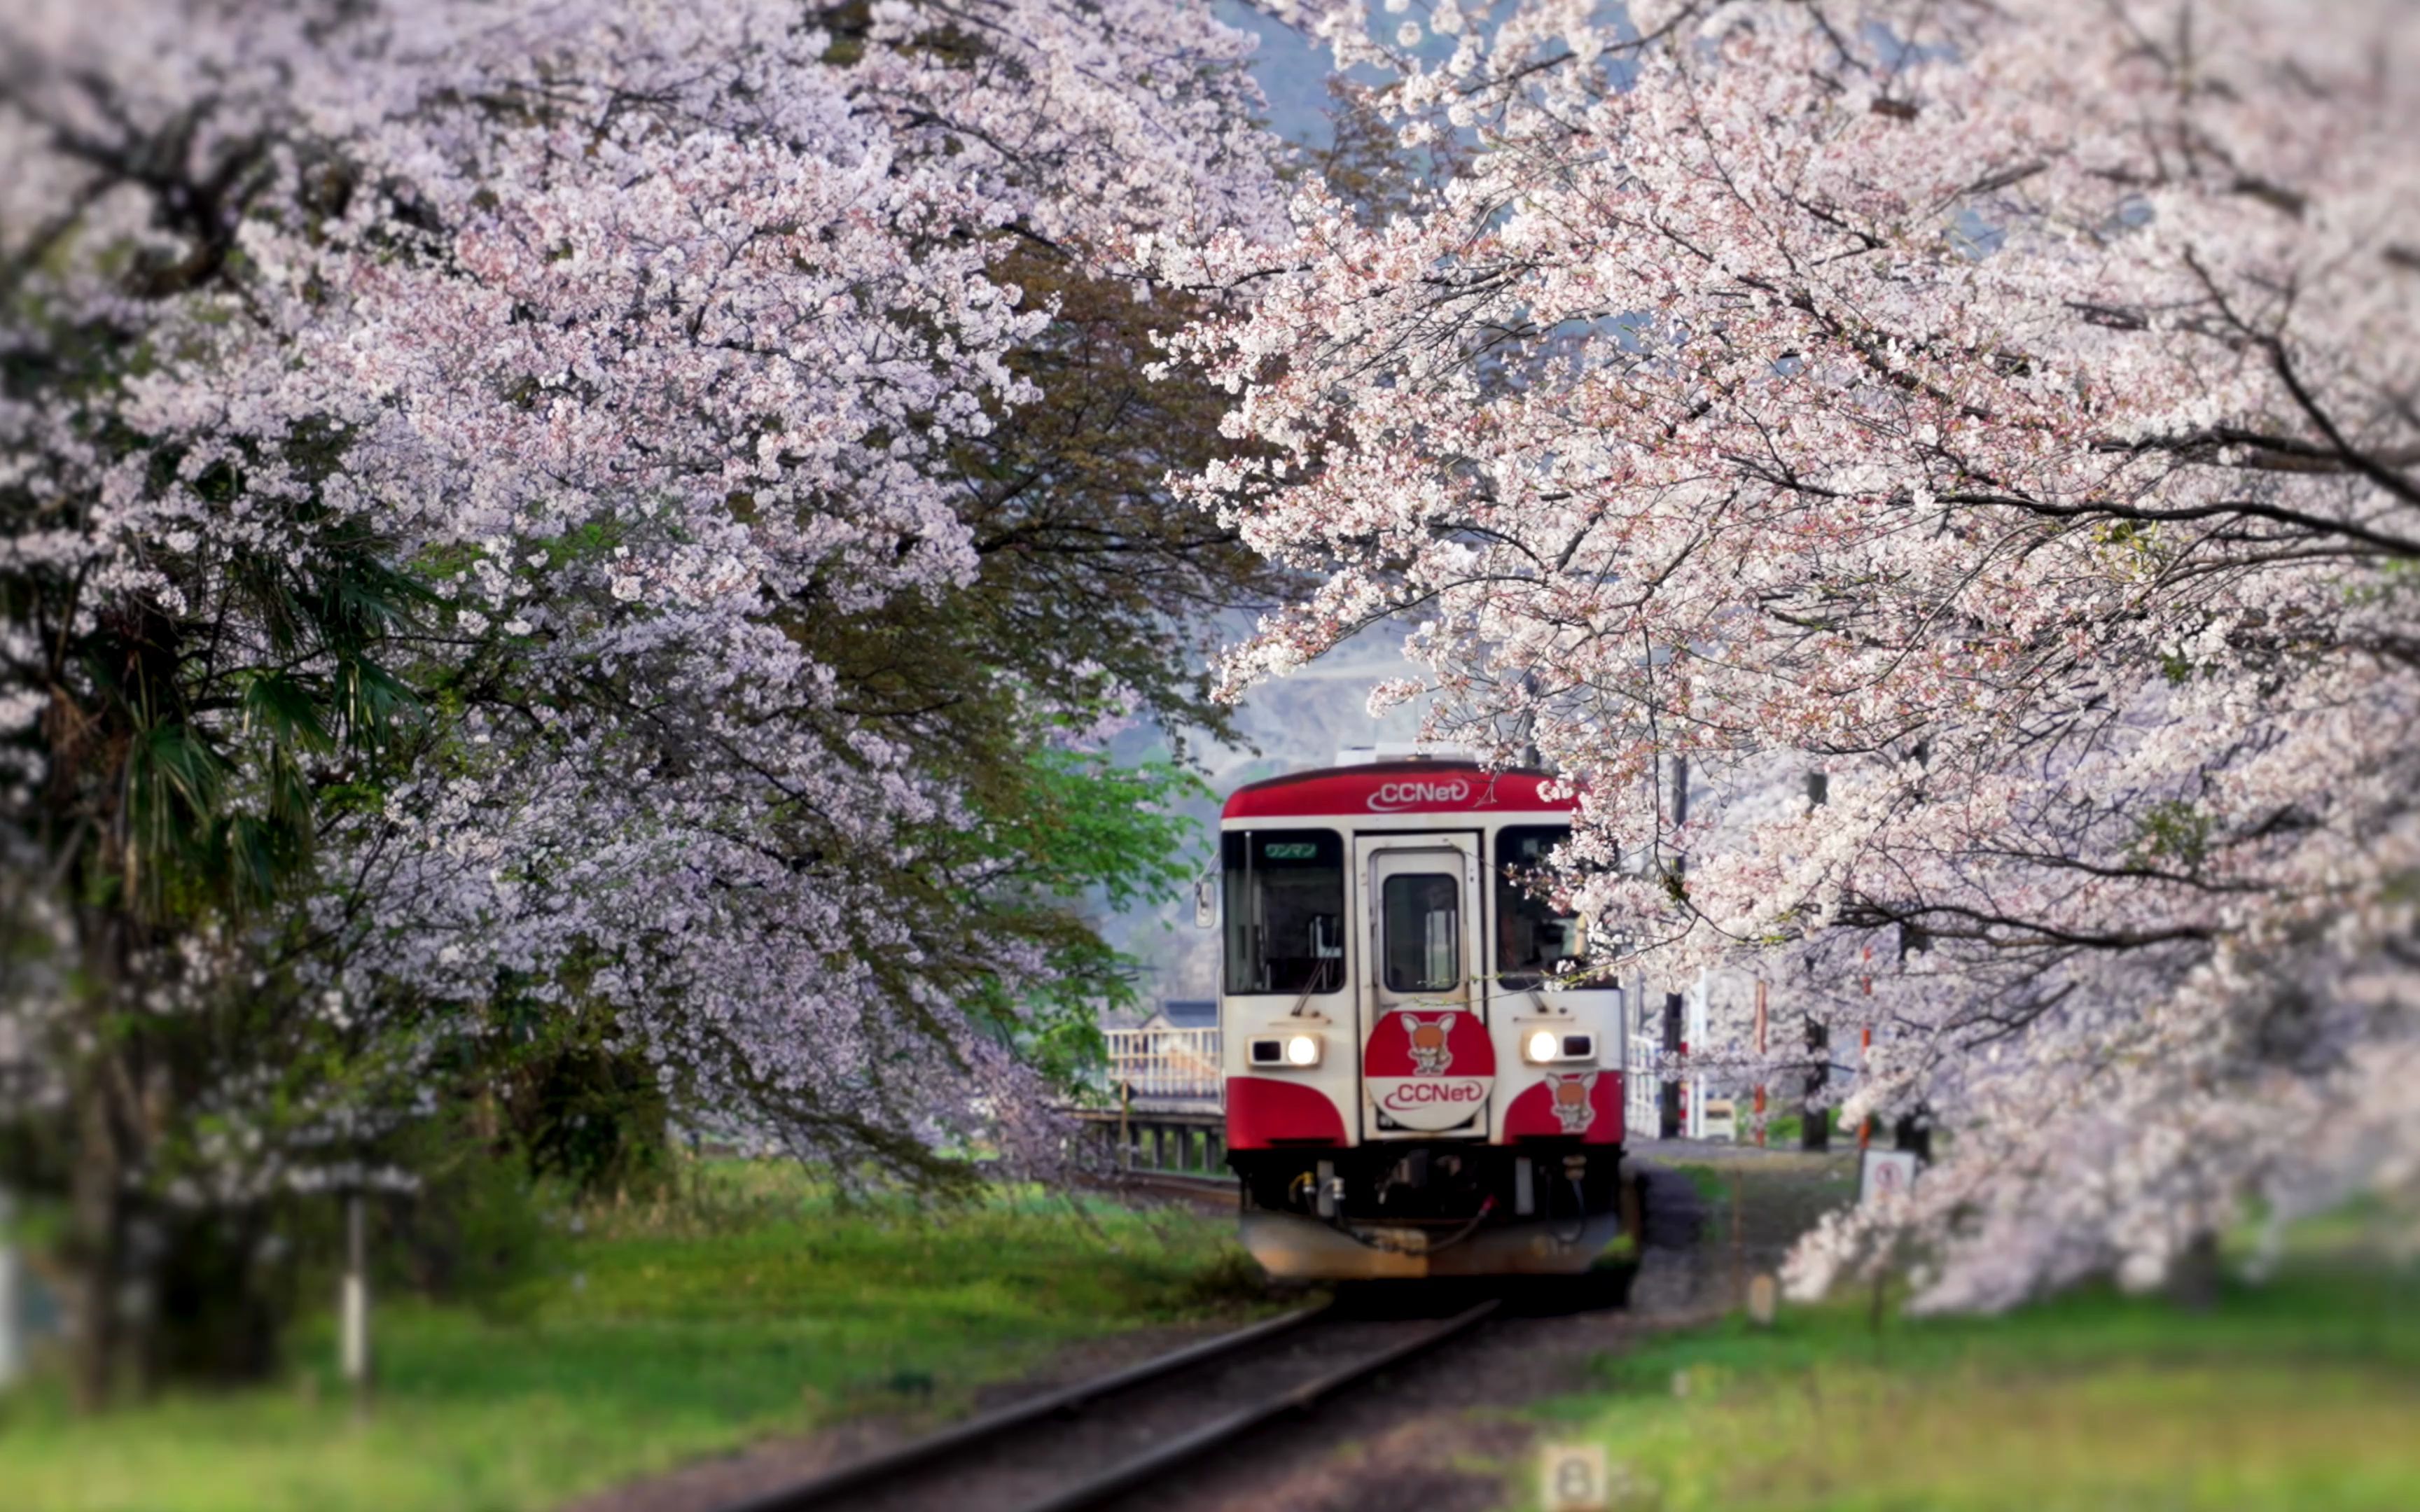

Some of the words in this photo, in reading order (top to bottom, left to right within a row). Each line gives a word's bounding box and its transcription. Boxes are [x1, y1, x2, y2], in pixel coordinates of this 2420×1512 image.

[1379, 779, 1469, 804] CCNet
[1265, 844, 1316, 858] ワンマン
[1396, 1080, 1482, 1102] CCNet
